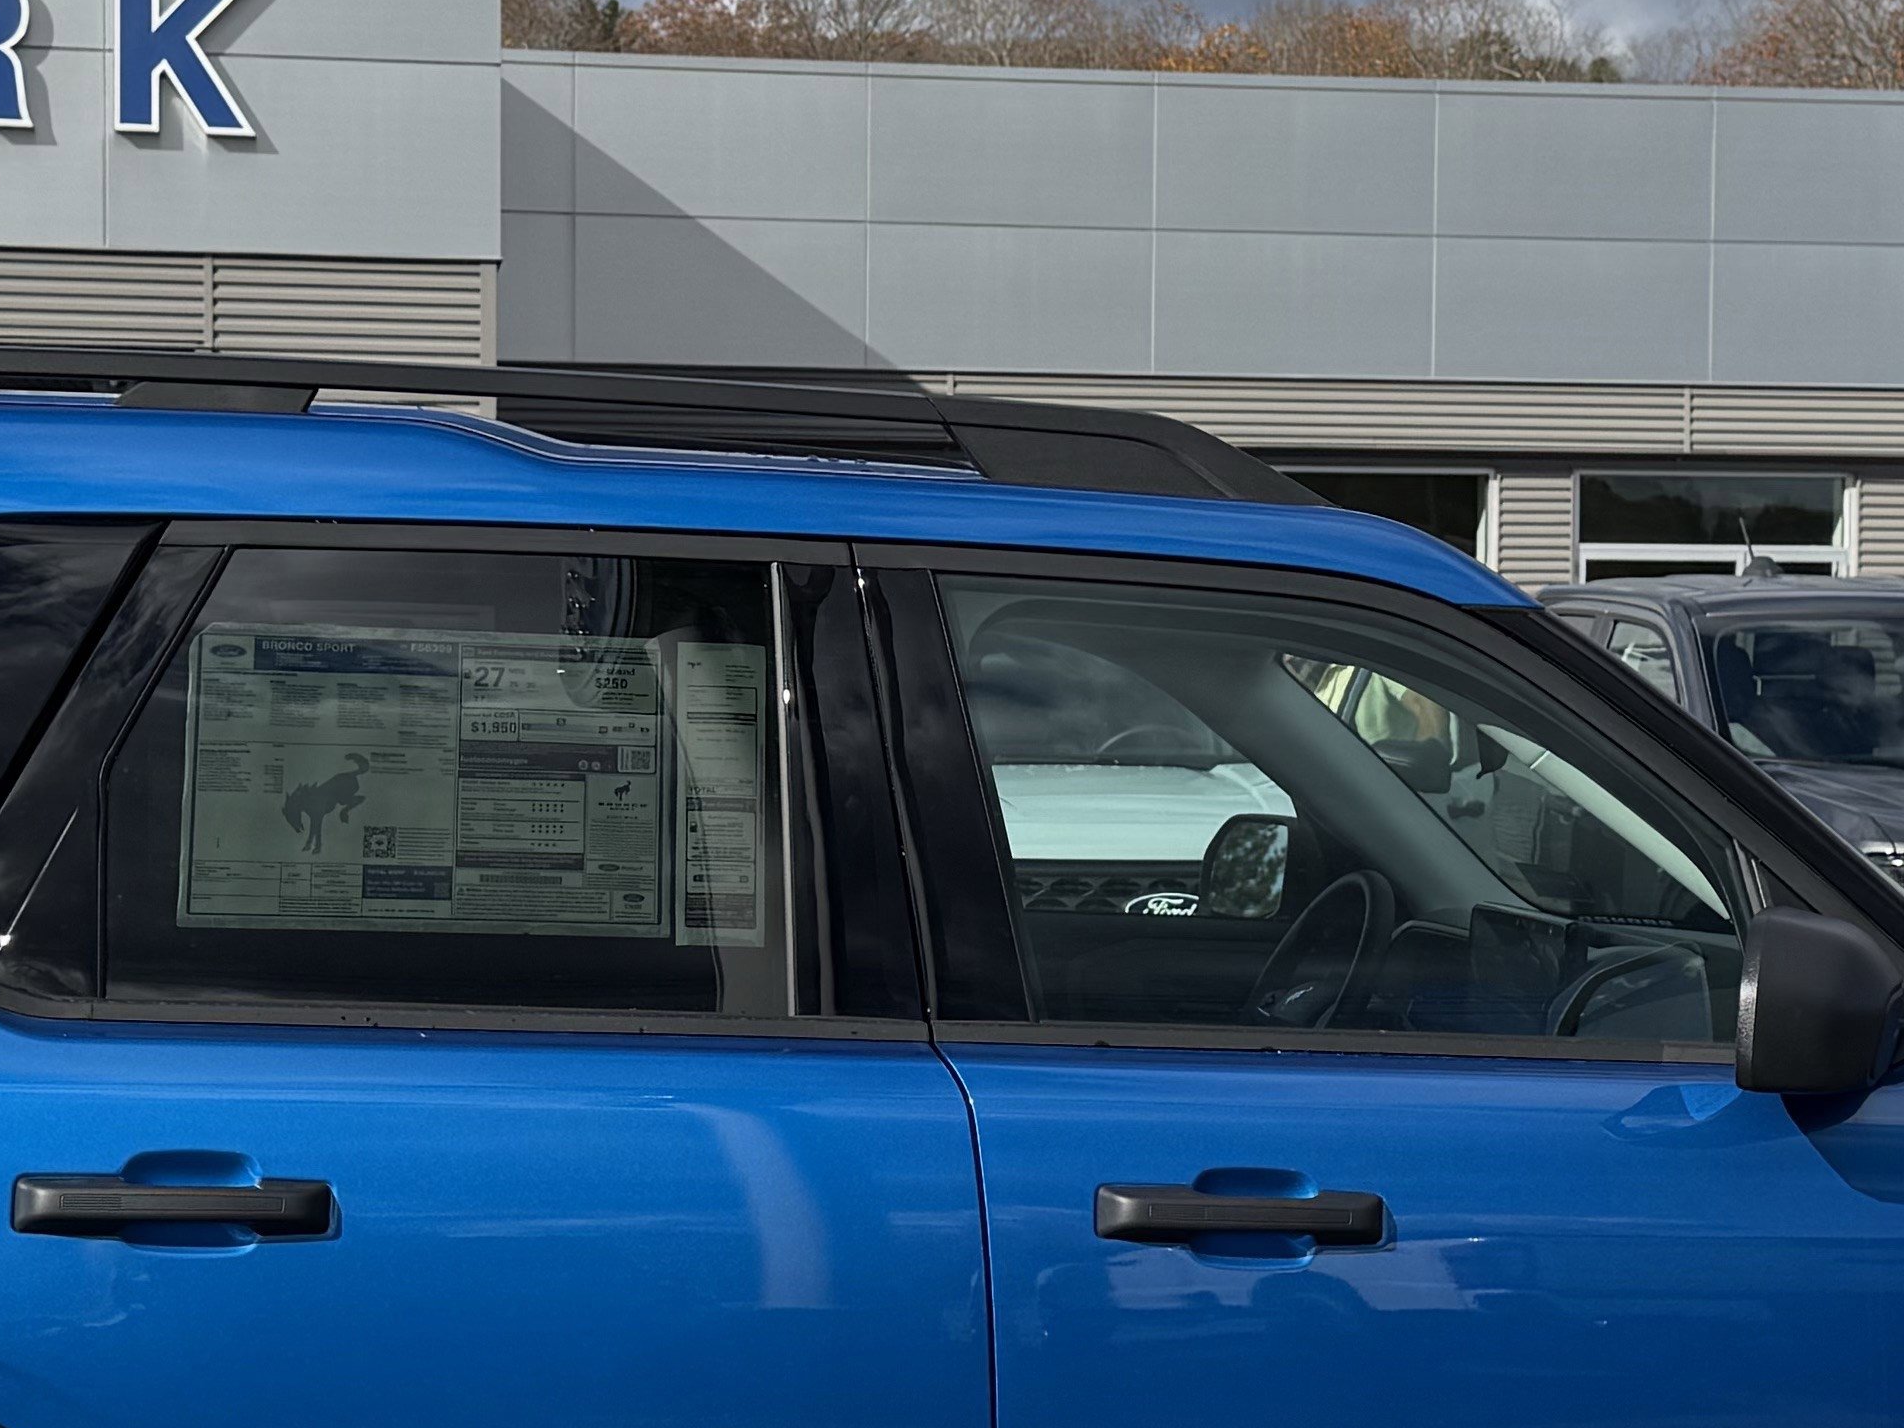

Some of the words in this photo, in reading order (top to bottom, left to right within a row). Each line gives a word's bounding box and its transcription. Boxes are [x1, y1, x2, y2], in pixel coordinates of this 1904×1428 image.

[261, 640, 313, 652] BRONCO
[316, 642, 354, 653] SPORT
[474, 666, 506, 687] 27
